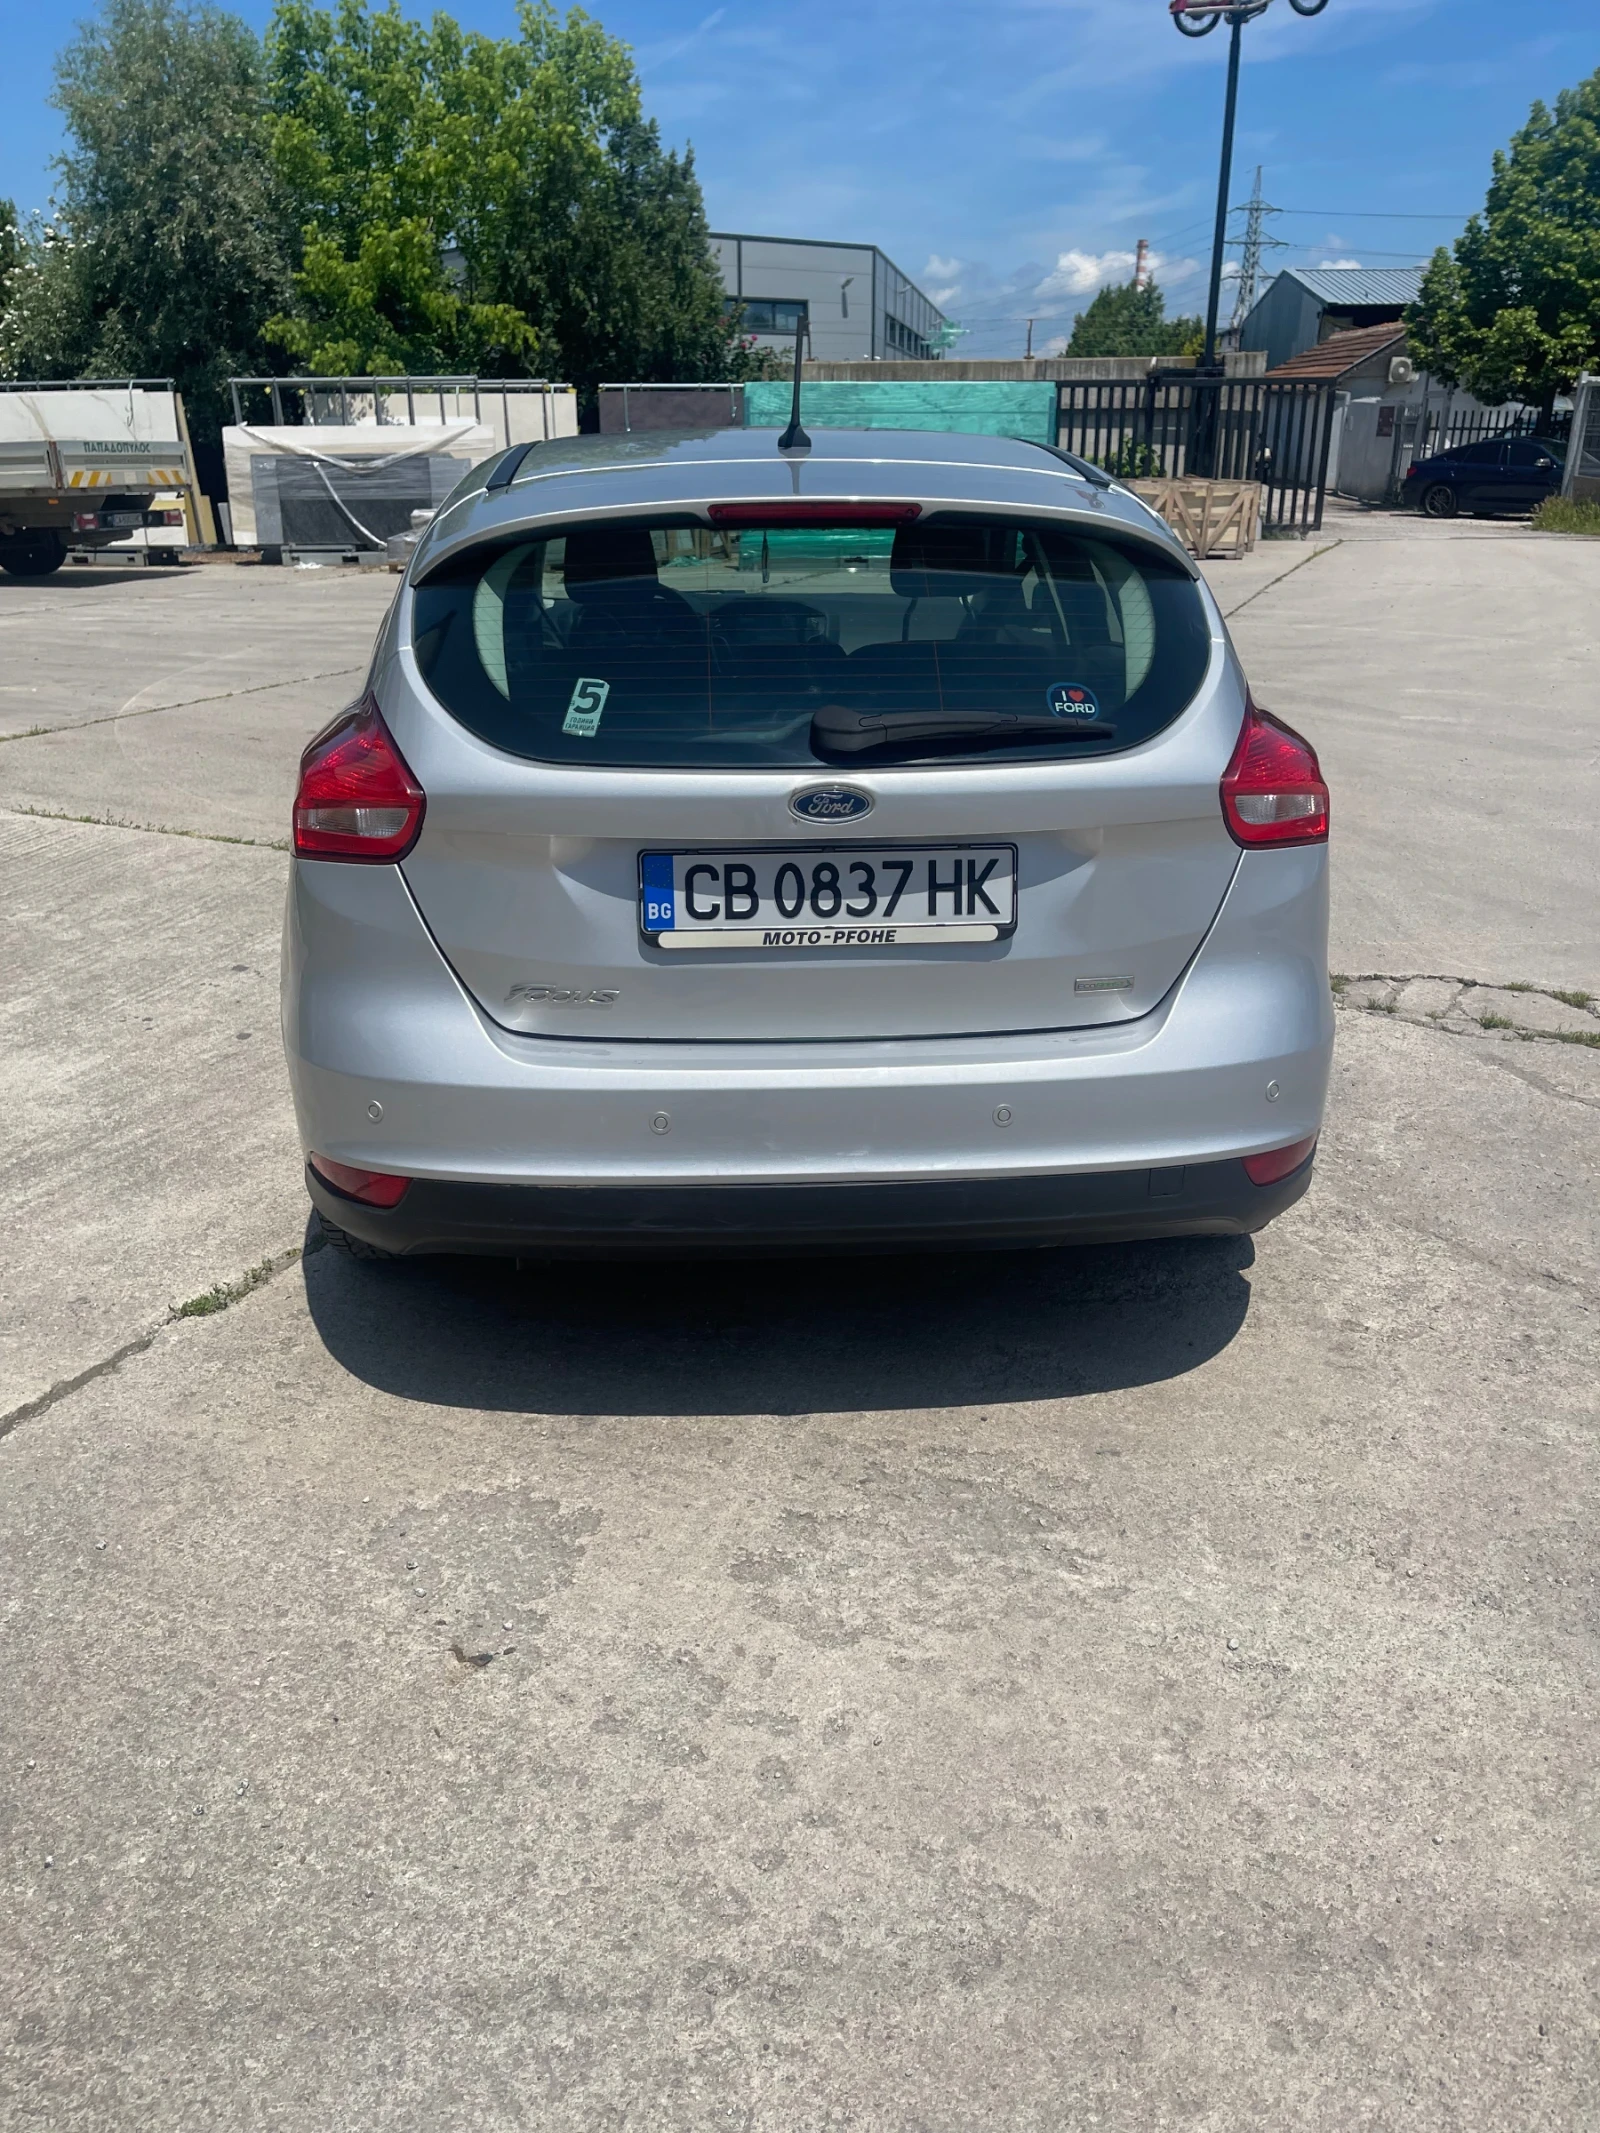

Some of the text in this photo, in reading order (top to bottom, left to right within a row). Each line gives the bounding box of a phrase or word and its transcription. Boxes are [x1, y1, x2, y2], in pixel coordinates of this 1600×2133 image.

[573, 681, 606, 714] 5
[1061, 690, 1067, 701] I
[1055, 702, 1095, 713] FORD
[564, 722, 595, 731] ГАРАНЦИЯ
[569, 716, 594, 725] ГОДИНИ
[808, 793, 855, 813] Ford
[684, 858, 1001, 920] CB 0837 HK
[648, 902, 671, 919] BG
